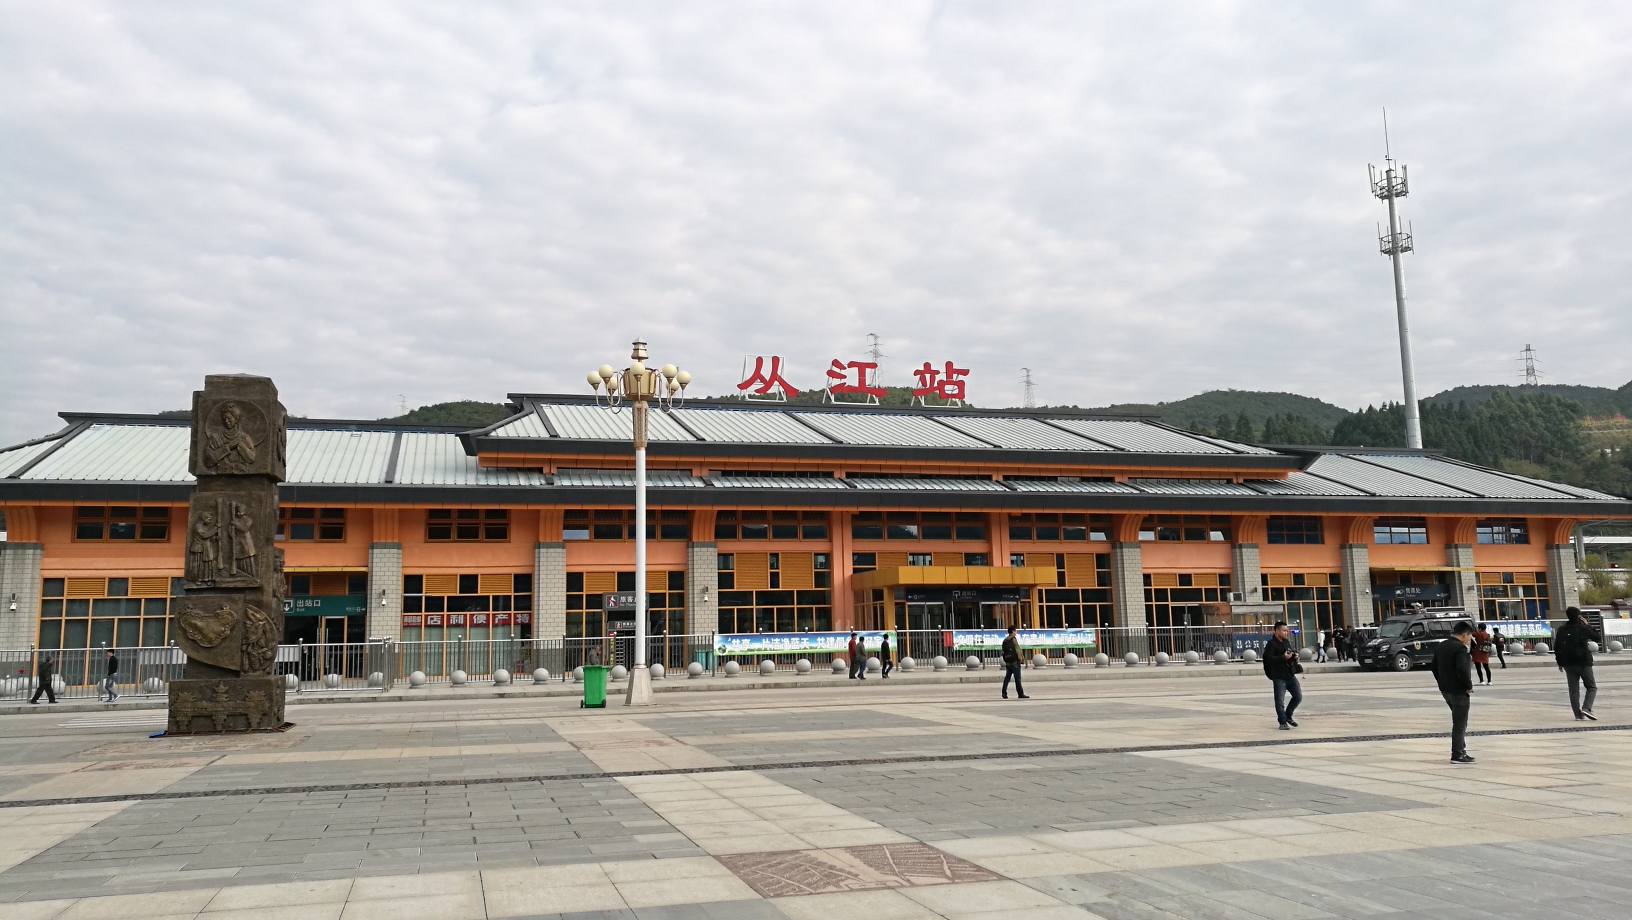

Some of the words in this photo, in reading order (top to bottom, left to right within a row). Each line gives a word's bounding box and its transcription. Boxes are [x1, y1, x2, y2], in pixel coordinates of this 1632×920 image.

[737, 356, 970, 400] 从江站
[296, 599, 321, 607] 出站口
[1004, 633, 1046, 645] 在贵州
